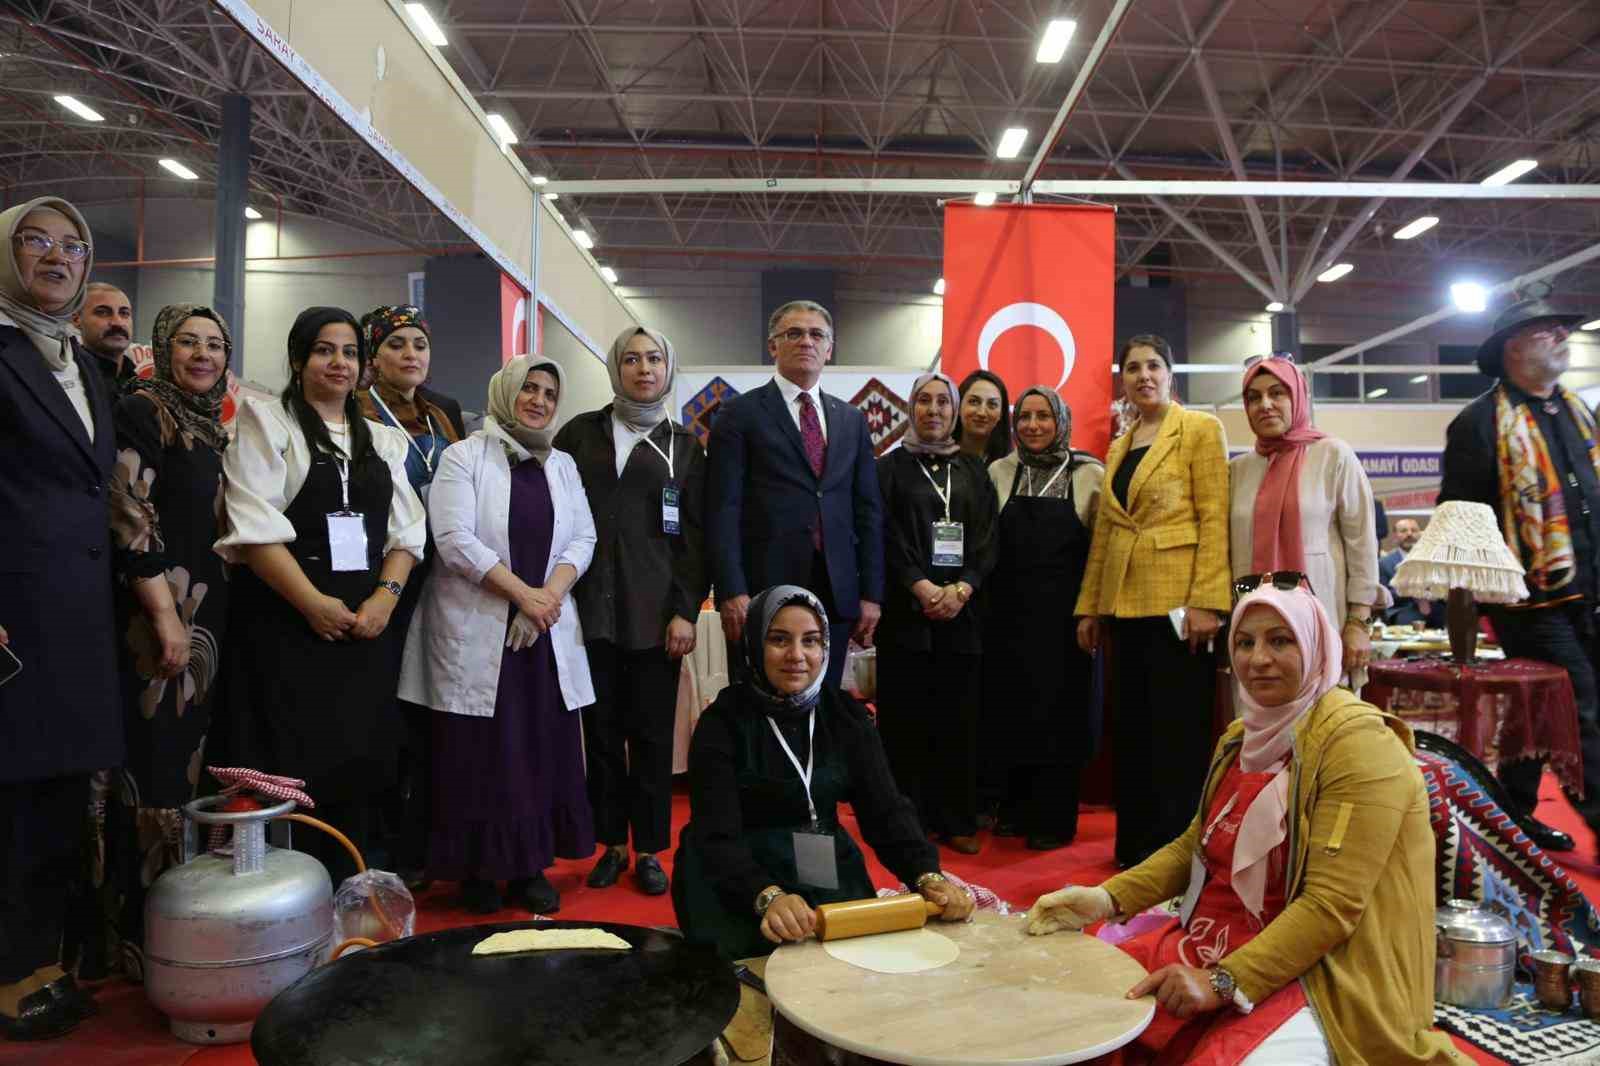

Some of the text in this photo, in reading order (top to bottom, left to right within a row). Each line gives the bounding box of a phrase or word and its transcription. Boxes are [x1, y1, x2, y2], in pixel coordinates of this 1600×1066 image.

[256, 17, 296, 63] SARAY
[1361, 455, 1440, 473] ANAYİ ODASI
